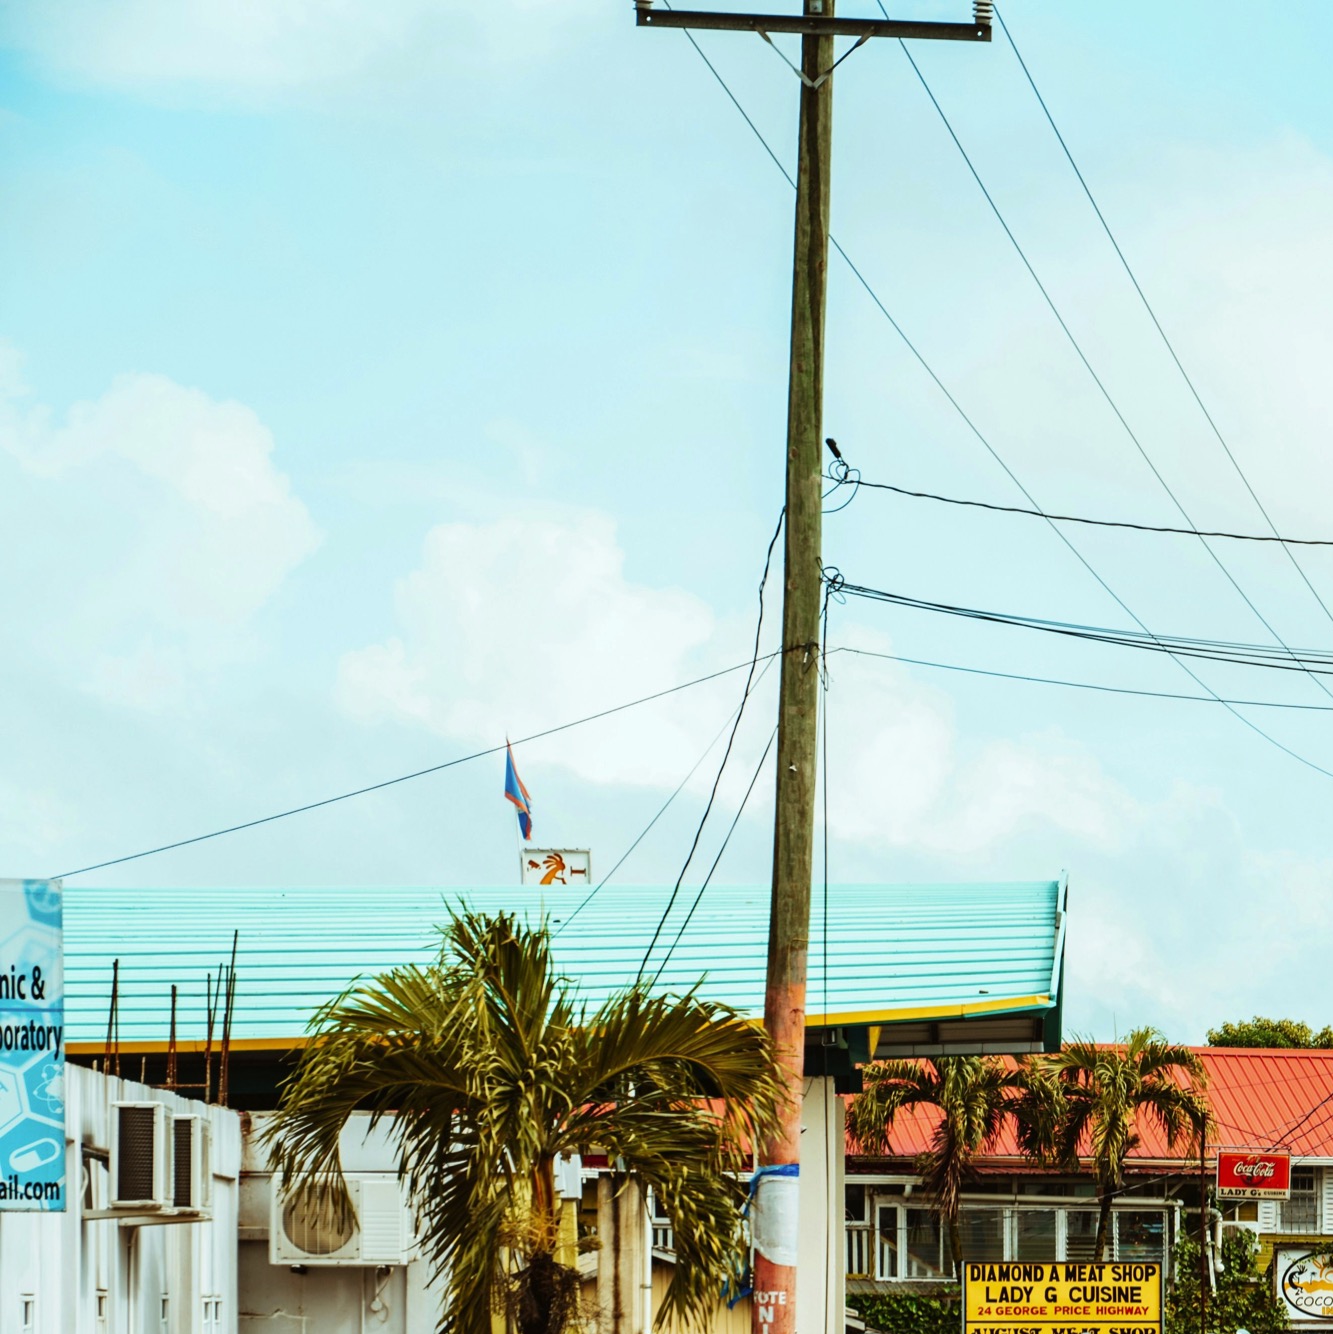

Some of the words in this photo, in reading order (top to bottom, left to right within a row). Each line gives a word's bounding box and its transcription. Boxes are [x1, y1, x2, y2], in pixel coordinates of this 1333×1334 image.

[31, 966, 45, 1000] &
[0, 1020, 62, 1061] oratory
[1233, 1162, 1276, 1177] Coca-Cola
[970, 1265, 1044, 1282] DIAMOND
[1049, 1265, 1060, 1282] A
[1065, 1265, 1106, 1282] MEAT
[1112, 1265, 1157, 1282] SHOP
[985, 1286, 1034, 1303] LADY
[1044, 1286, 1058, 1303] G
[1069, 1286, 1142, 1303] CUISINE
[978, 1306, 992, 1315] 24
[995, 1306, 1048, 1316] GEORGE
[1054, 1306, 1090, 1315] PRICE
[1096, 1306, 1149, 1316] HIGHWAY
